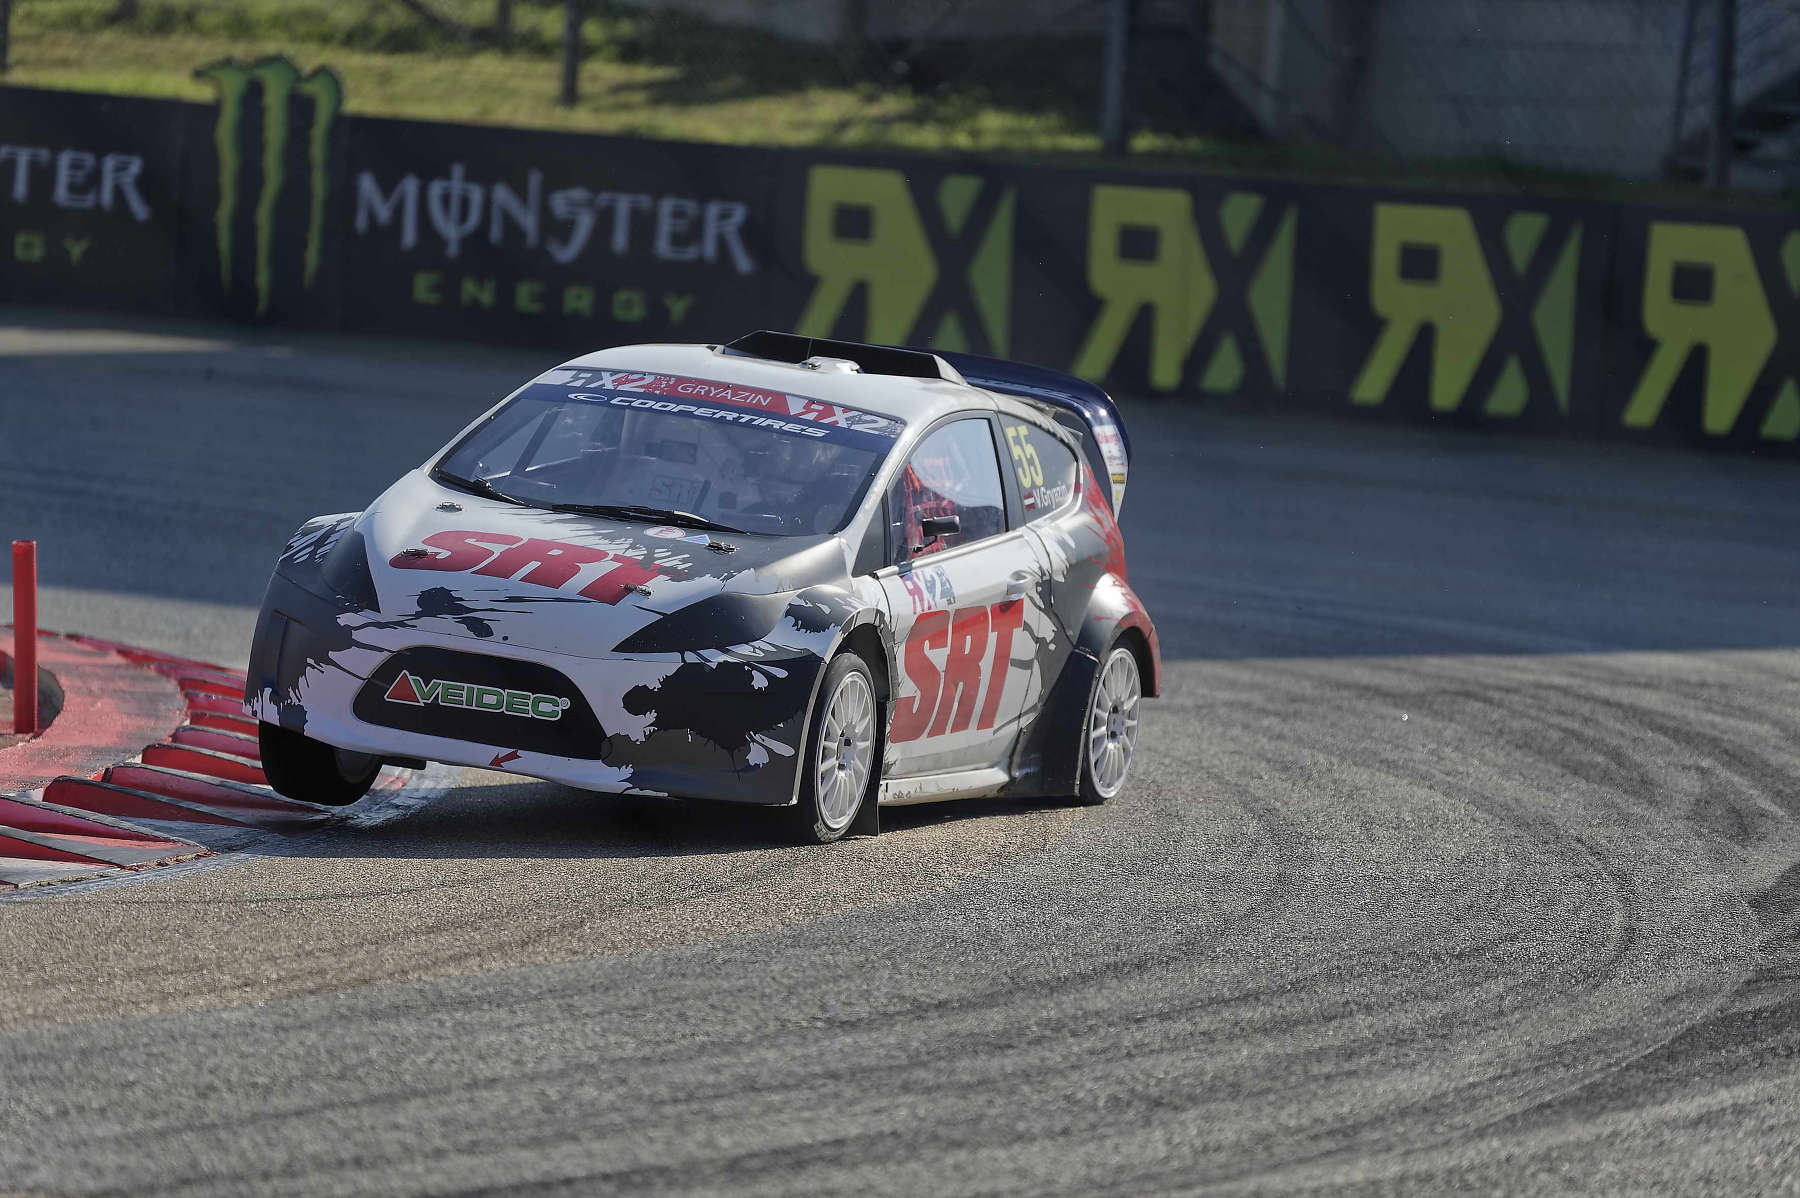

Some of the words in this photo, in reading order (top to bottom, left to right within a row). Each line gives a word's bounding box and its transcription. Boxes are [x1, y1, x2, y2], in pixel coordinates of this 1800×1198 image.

[355, 164, 755, 275] MONSTER
[413, 271, 695, 324] ENERGY
[677, 382, 773, 407] GRYAZIN
[1006, 426, 1043, 488] 55
[388, 530, 687, 606] SRT
[889, 599, 1024, 744] SRT
